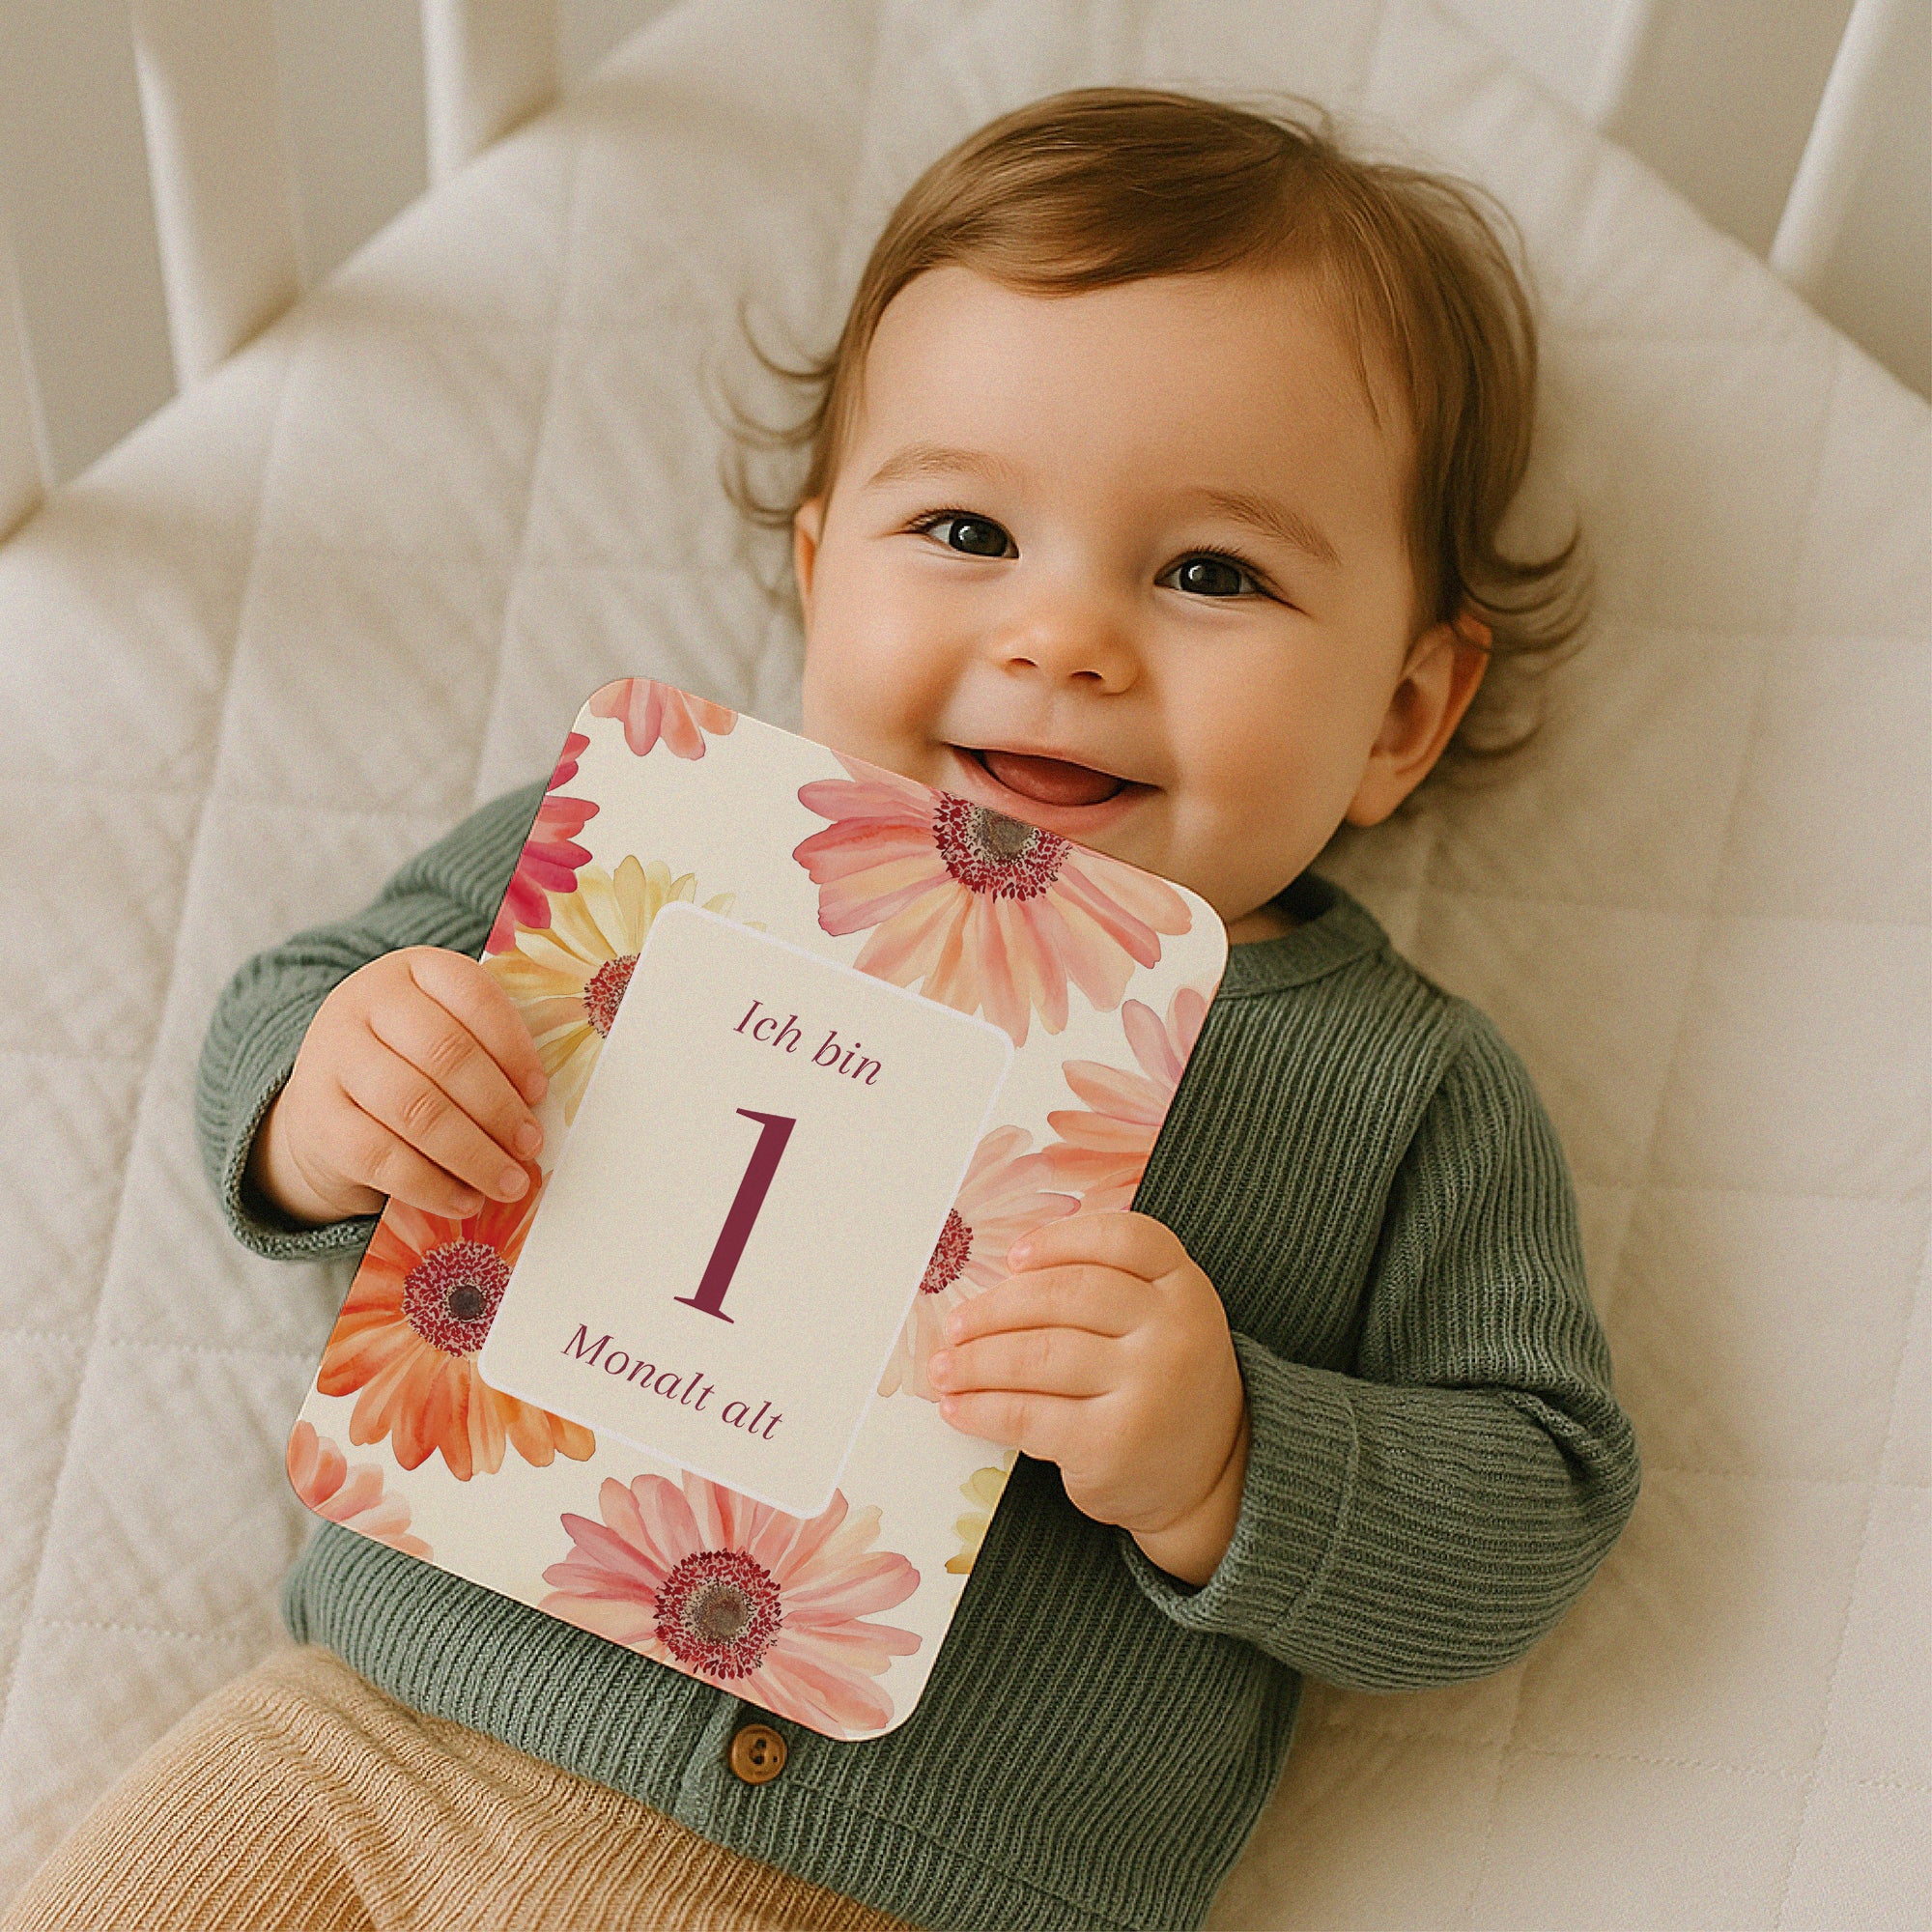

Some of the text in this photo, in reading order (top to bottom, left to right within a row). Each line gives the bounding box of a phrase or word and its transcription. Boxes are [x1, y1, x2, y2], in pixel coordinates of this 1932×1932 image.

[732, 999, 883, 1086] Ich bin
[673, 1108, 797, 1324] 1
[560, 1322, 784, 1440] Monalt alt
